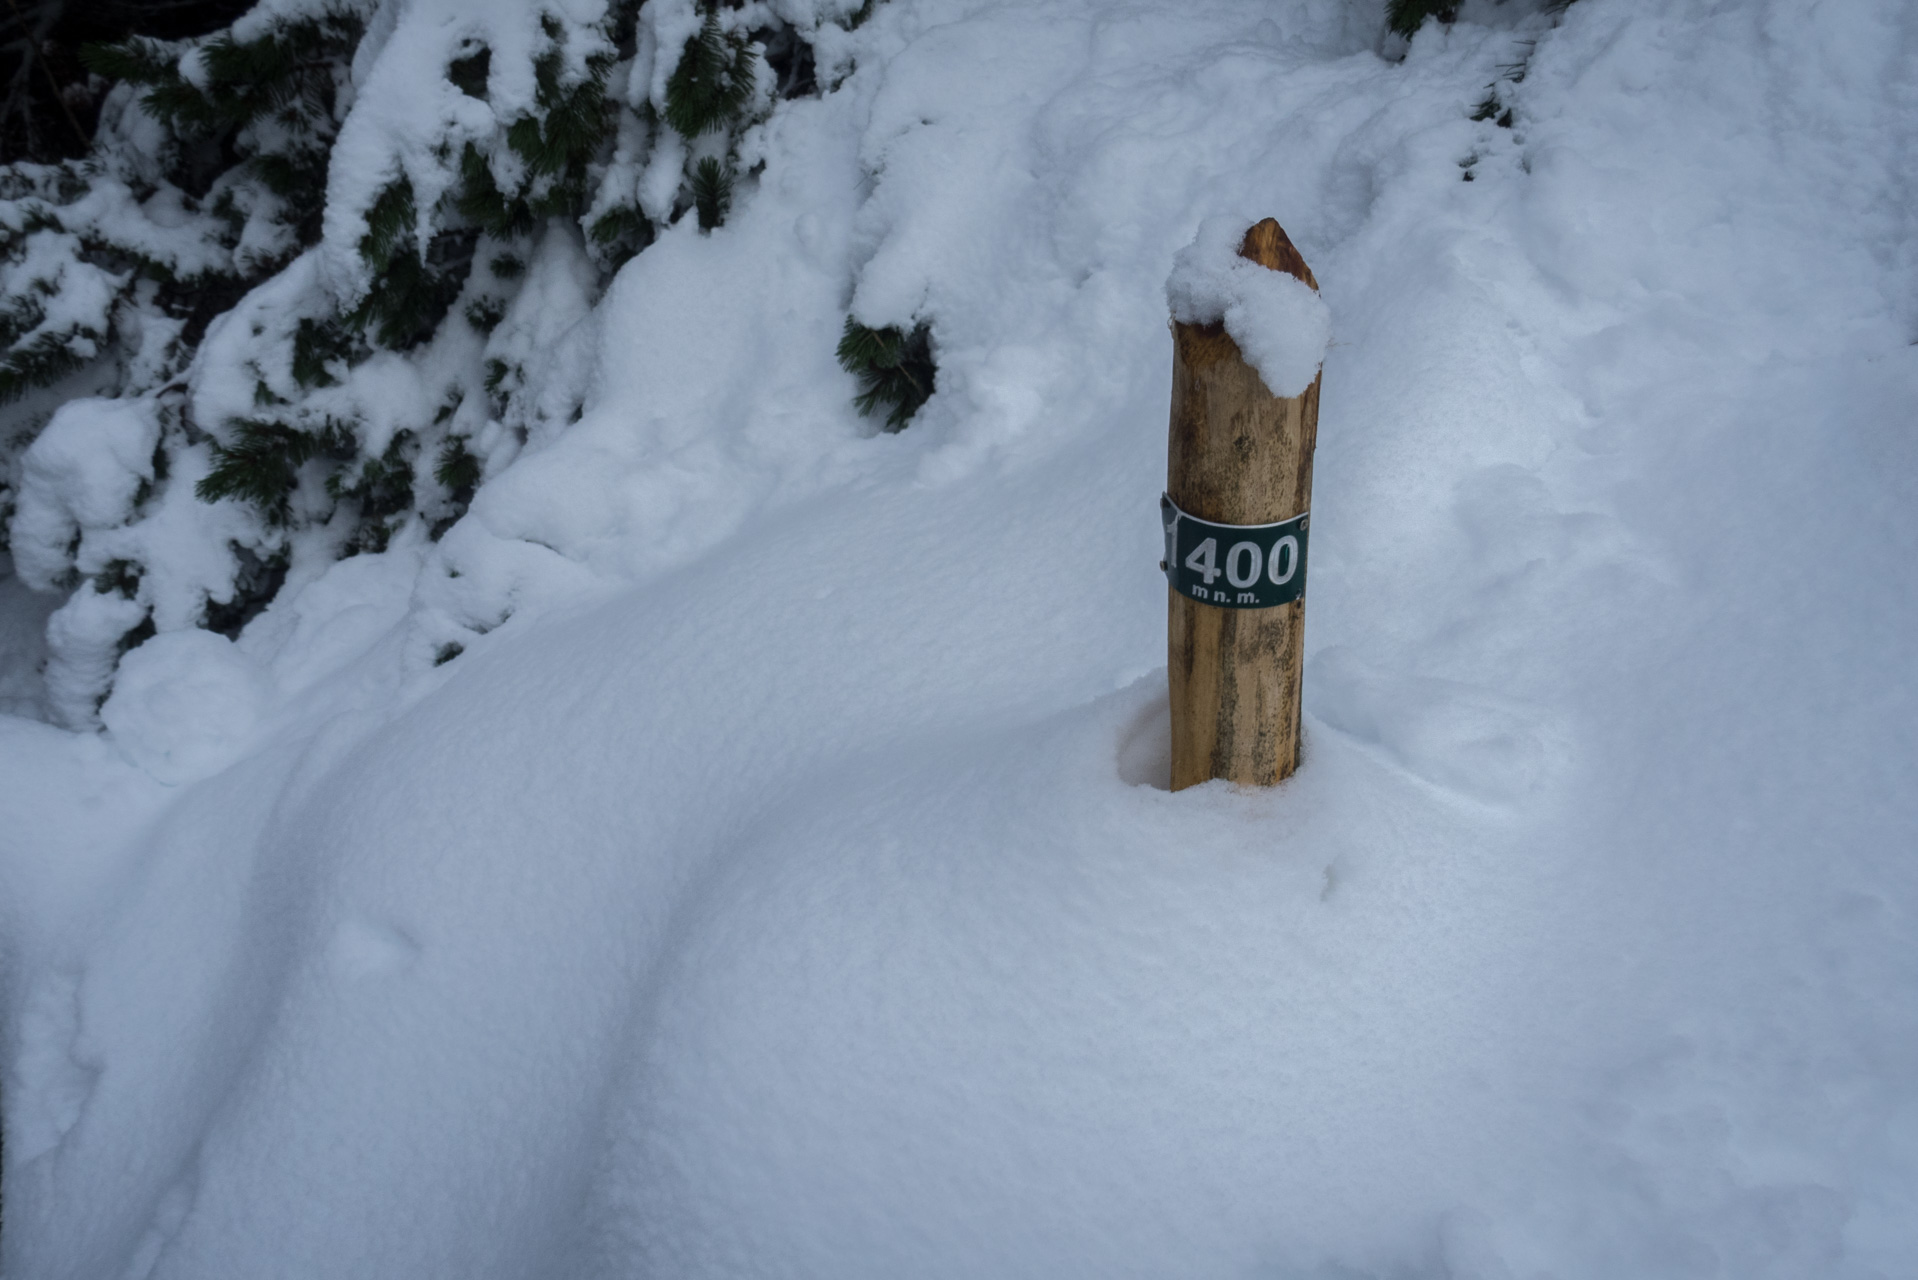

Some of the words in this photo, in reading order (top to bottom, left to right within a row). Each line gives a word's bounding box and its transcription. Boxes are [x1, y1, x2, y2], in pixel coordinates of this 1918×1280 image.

[1166, 513, 1299, 589] 1400
[1192, 584, 1208, 599] m
[1213, 590, 1231, 603] n.
[1237, 592, 1260, 604] m.
